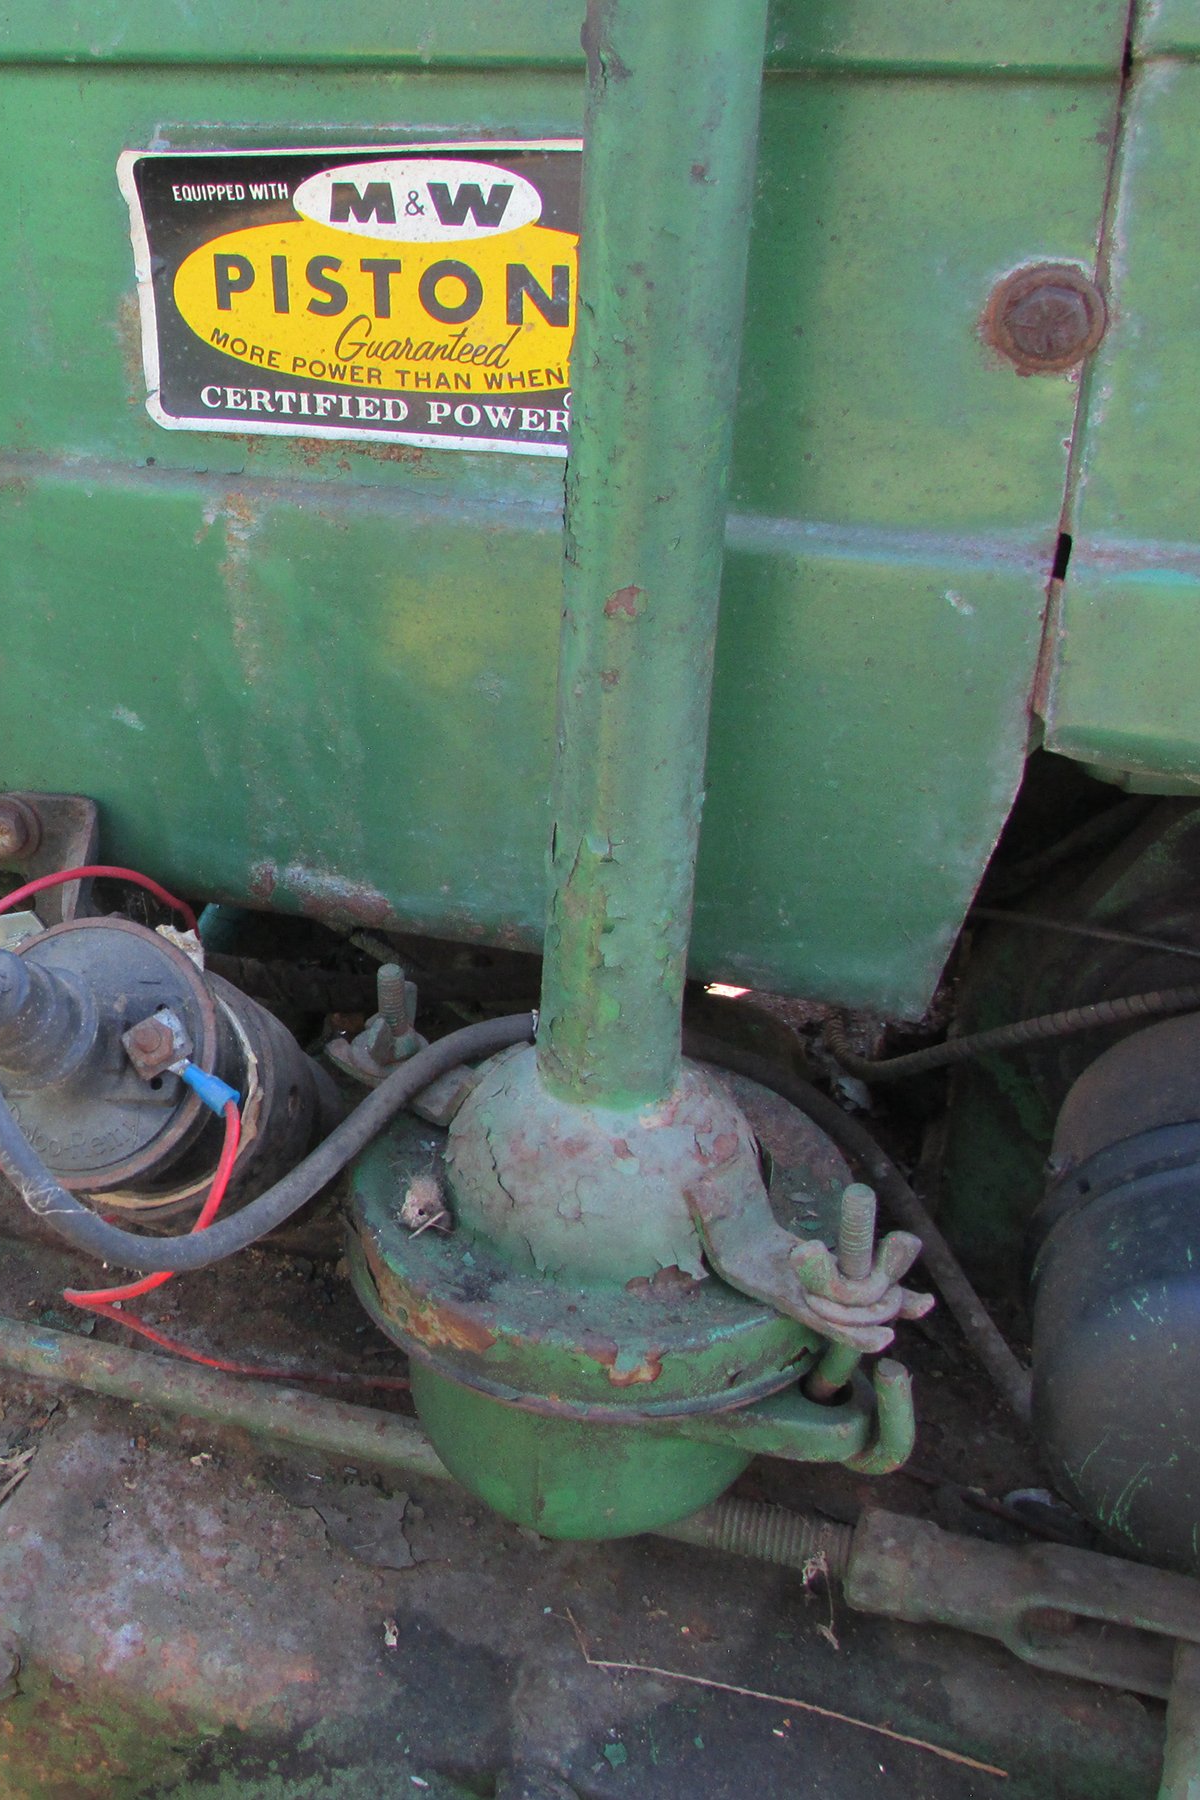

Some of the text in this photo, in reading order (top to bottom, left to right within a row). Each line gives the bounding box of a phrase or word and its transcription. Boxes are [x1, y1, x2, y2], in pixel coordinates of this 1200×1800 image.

[172, 182, 290, 202] EQUIPPED WITH
[329, 181, 514, 228] M&W
[212, 253, 570, 328] PISTON
[210, 328, 565, 390] MORE POWER THAN WHEN
[334, 314, 522, 369] Guaranteed
[200, 386, 570, 433] CERTIFIED POWER
